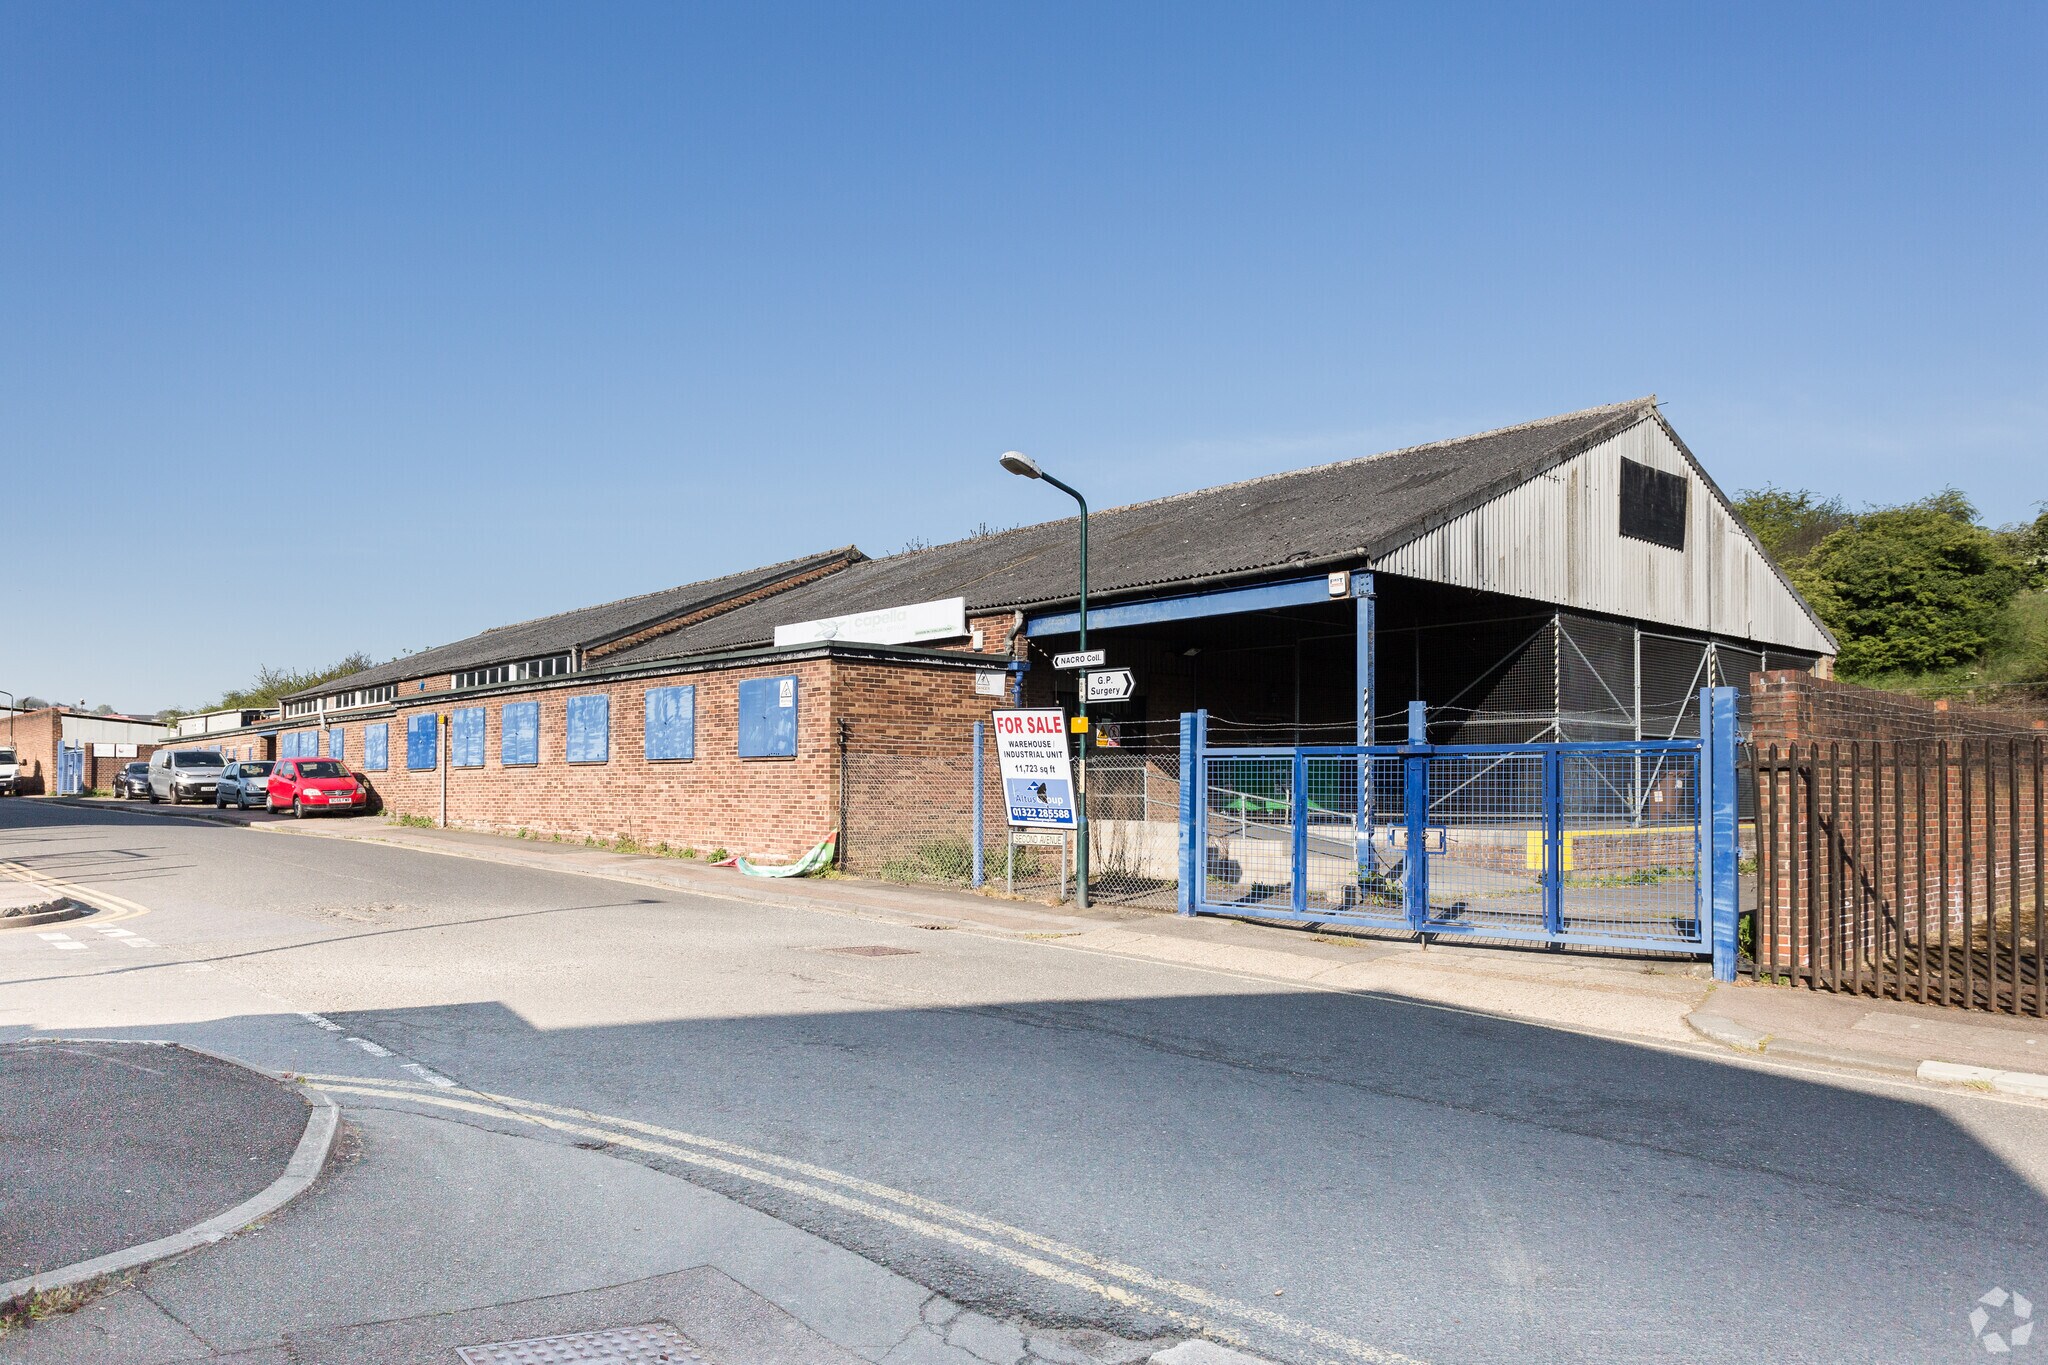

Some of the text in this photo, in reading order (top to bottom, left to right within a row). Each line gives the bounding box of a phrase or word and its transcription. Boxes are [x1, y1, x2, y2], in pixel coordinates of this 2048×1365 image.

[854, 609, 907, 628] capella
[1060, 654, 1102, 665] NACRO Coll.
[1097, 675, 1113, 685] G.P.
[1090, 687, 1121, 696] Surgery
[996, 716, 1063, 734] FOR SALE
[1008, 740, 1051, 748] WAREHOUSE
[1003, 750, 1063, 758] INDUSTRIAL UNIT
[1015, 764, 1056, 775] 11,723 sq ft
[1012, 807, 1070, 819] 01322 285588
[1015, 834, 1062, 844] SECOND AVENUE
